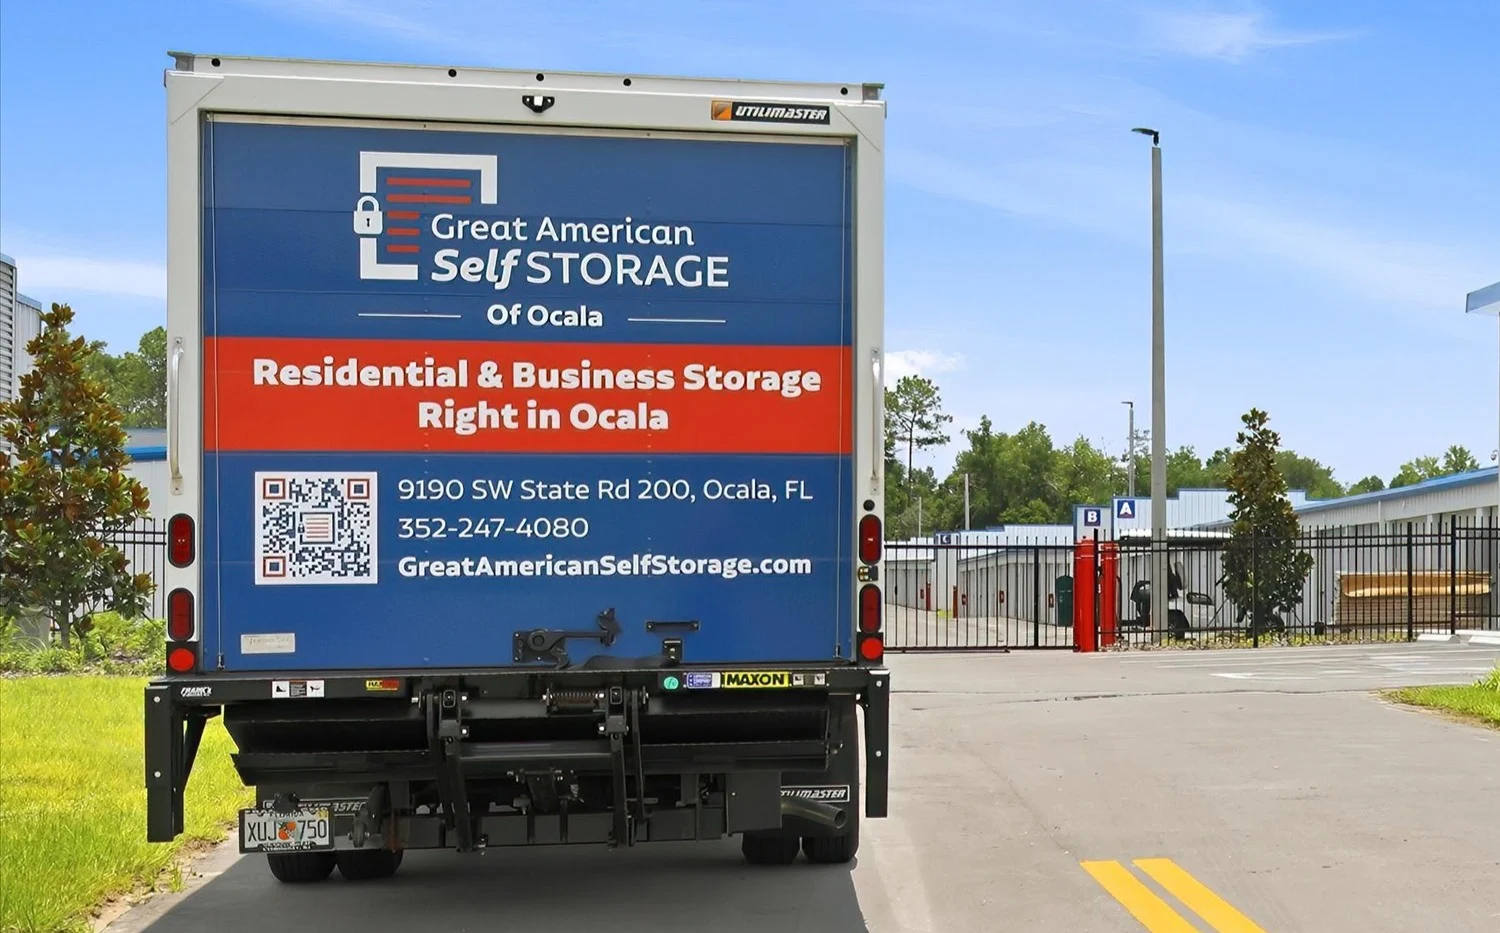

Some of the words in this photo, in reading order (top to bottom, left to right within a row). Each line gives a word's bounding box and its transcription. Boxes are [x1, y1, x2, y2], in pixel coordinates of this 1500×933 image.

[735, 105, 828, 120] UTILIMASTER
[431, 213, 528, 241] Great
[536, 216, 695, 246] American
[431, 248, 522, 290] Self
[526, 251, 729, 287] STORAGE
[487, 303, 522, 326] Of
[527, 305, 603, 327] Ocala
[253, 355, 468, 388] Residential
[477, 360, 503, 388] &
[513, 361, 675, 390] Business
[684, 363, 821, 397] Storage
[418, 398, 519, 436] Right
[527, 399, 561, 429] in
[569, 402, 669, 430] Ocala
[398, 479, 464, 500] 9190
[472, 479, 514, 500] SW
[520, 479, 590, 500] State
[598, 479, 630, 500] Rd
[638, 479, 696, 503] 200,
[703, 479, 777, 503] Ocala,
[786, 479, 814, 500] FL
[1087, 511, 1098, 523] B
[1119, 502, 1130, 515] A
[398, 517, 589, 539] 352-247-4080
[398, 553, 812, 580] GreatAmericanSelfStorage.com
[726, 674, 784, 686] MAXON
[248, 821, 277, 842] XUJ
[297, 819, 327, 840] 750
